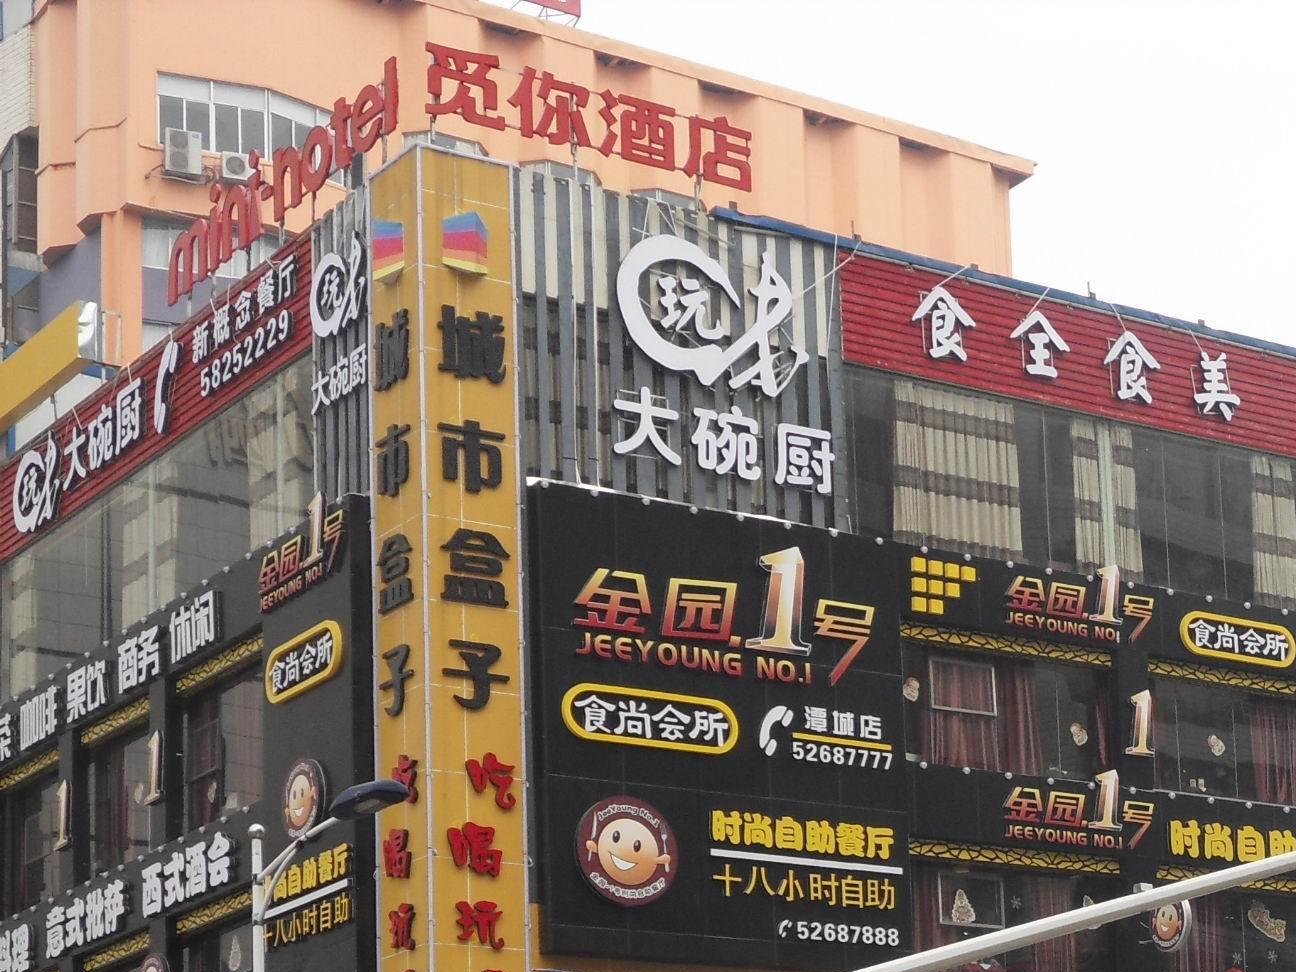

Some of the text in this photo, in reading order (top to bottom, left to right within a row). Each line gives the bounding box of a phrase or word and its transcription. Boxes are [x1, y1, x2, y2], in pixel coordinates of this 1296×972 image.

[425, 42, 754, 193] 觅你酒店
[191, 255, 297, 362] 新概念餐厅
[199, 310, 293, 398] 58252229
[311, 340, 368, 410] 大碗厨
[911, 286, 1241, 422] 食全食美
[61, 378, 145, 485] 大碗厨
[612, 387, 836, 496] 大碗厨
[374, 308, 415, 717] 城市盒子
[436, 304, 511, 711] 城市盒子
[260, 574, 303, 613] JEEYOUNG
[1005, 612, 1085, 640] JEEYOUNG
[117, 625, 160, 694] 商务
[169, 590, 216, 664] 休闲
[576, 630, 742, 677] JEEYOUNG
[1187, 617, 1289, 663] 食尚会所
[66, 659, 107, 724] 果饮
[270, 632, 333, 692] 食尚会所
[20, 685, 57, 751] 咖啡
[574, 694, 729, 747] 食尚会所
[803, 706, 882, 740] 潭城店
[792, 742, 893, 771] 52687777
[710, 810, 894, 860] 时尚自助餐厅
[1005, 823, 1088, 847] JEEYOUNG
[141, 832, 232, 918] 西式酒会
[713, 863, 895, 910] 十八小时自助
[46, 879, 124, 959] 意式批萨
[797, 921, 900, 947] 52687888
